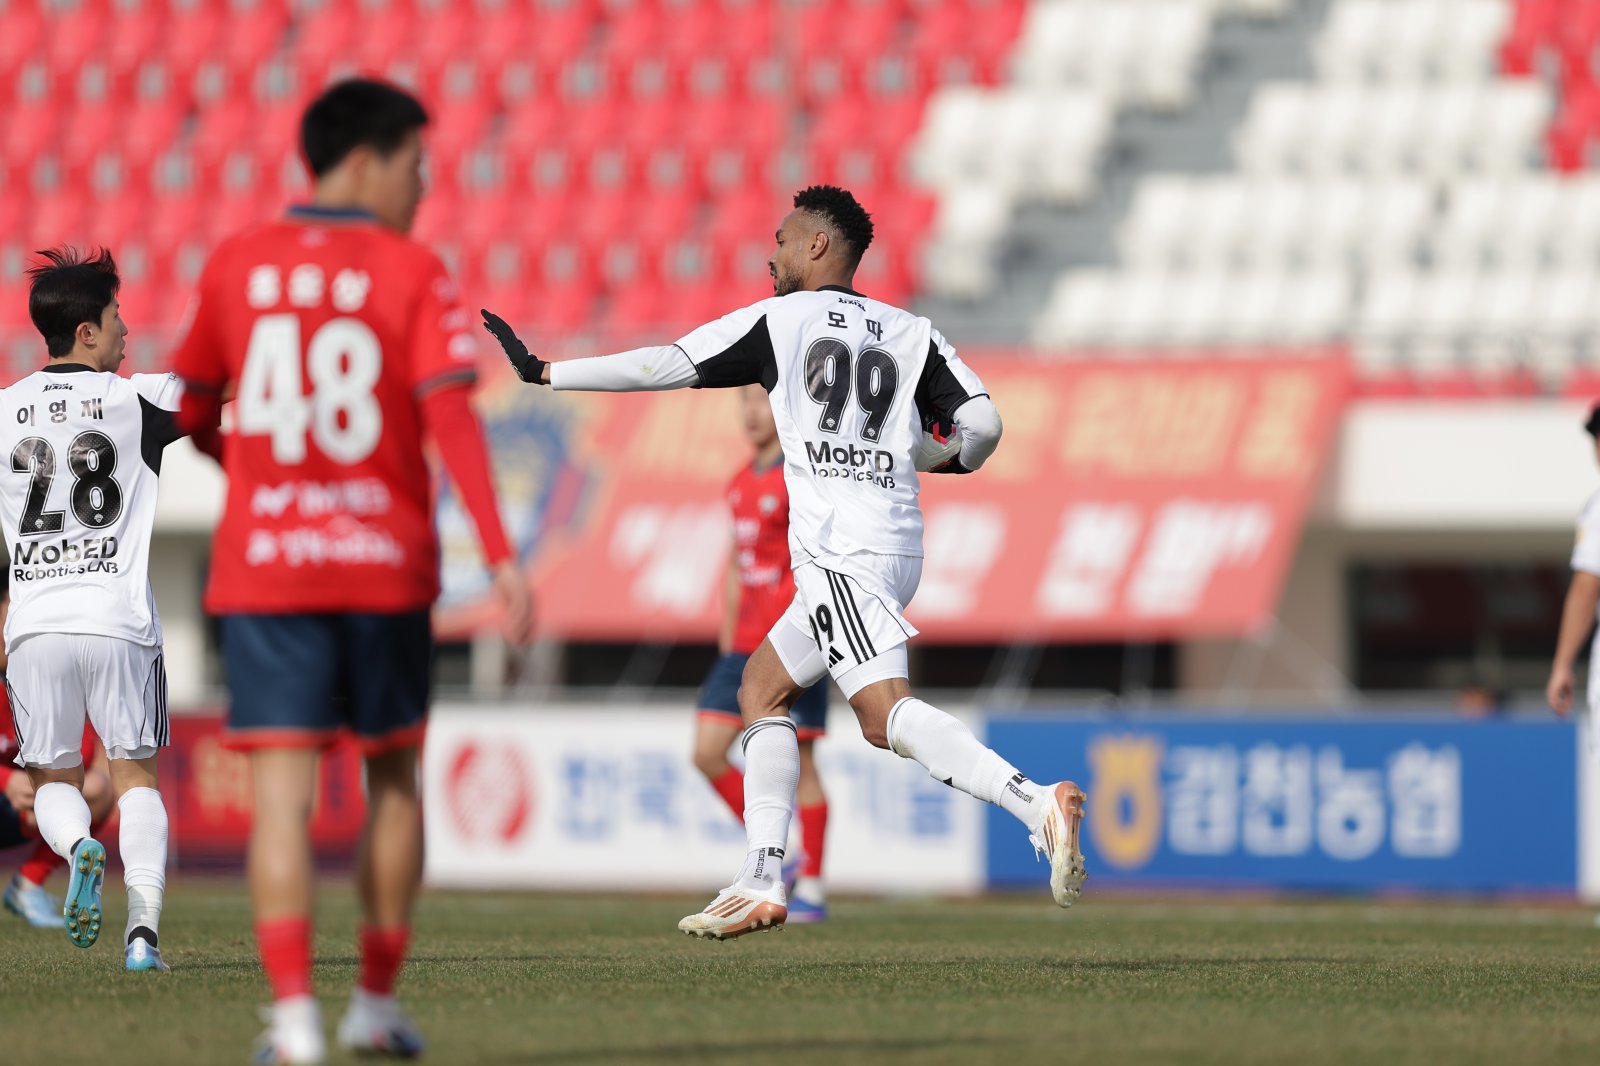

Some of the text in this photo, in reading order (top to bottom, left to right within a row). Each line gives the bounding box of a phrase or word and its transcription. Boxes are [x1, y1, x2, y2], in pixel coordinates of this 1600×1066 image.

[828, 311, 884, 342] 모따
[16, 398, 104, 427] 이영재
[236, 313, 384, 466] 48
[804, 337, 899, 444] 99
[10, 430, 124, 536] 28
[13, 536, 119, 566] MobED
[1168, 742, 1463, 859] 김천농협
